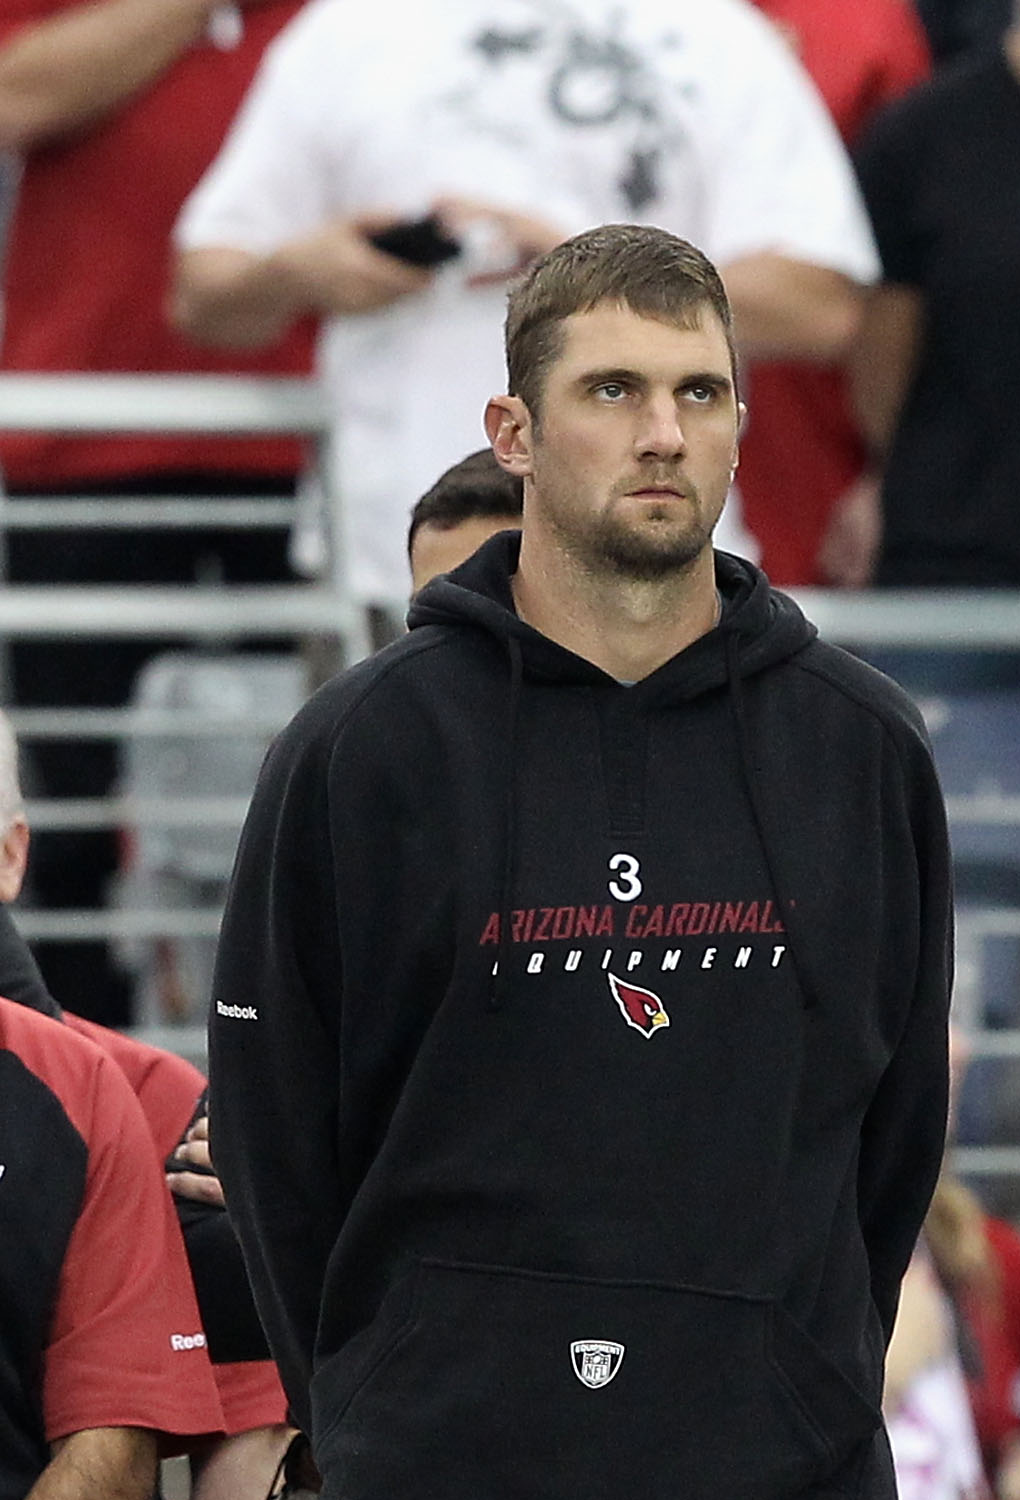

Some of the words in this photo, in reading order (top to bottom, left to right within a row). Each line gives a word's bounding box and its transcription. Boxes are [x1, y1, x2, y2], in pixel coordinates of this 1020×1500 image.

[608, 853, 642, 901] 3
[479, 904, 615, 945] ARIZONA
[216, 1000, 258, 1020] Reebok
[170, 1333, 208, 1351] Ree
